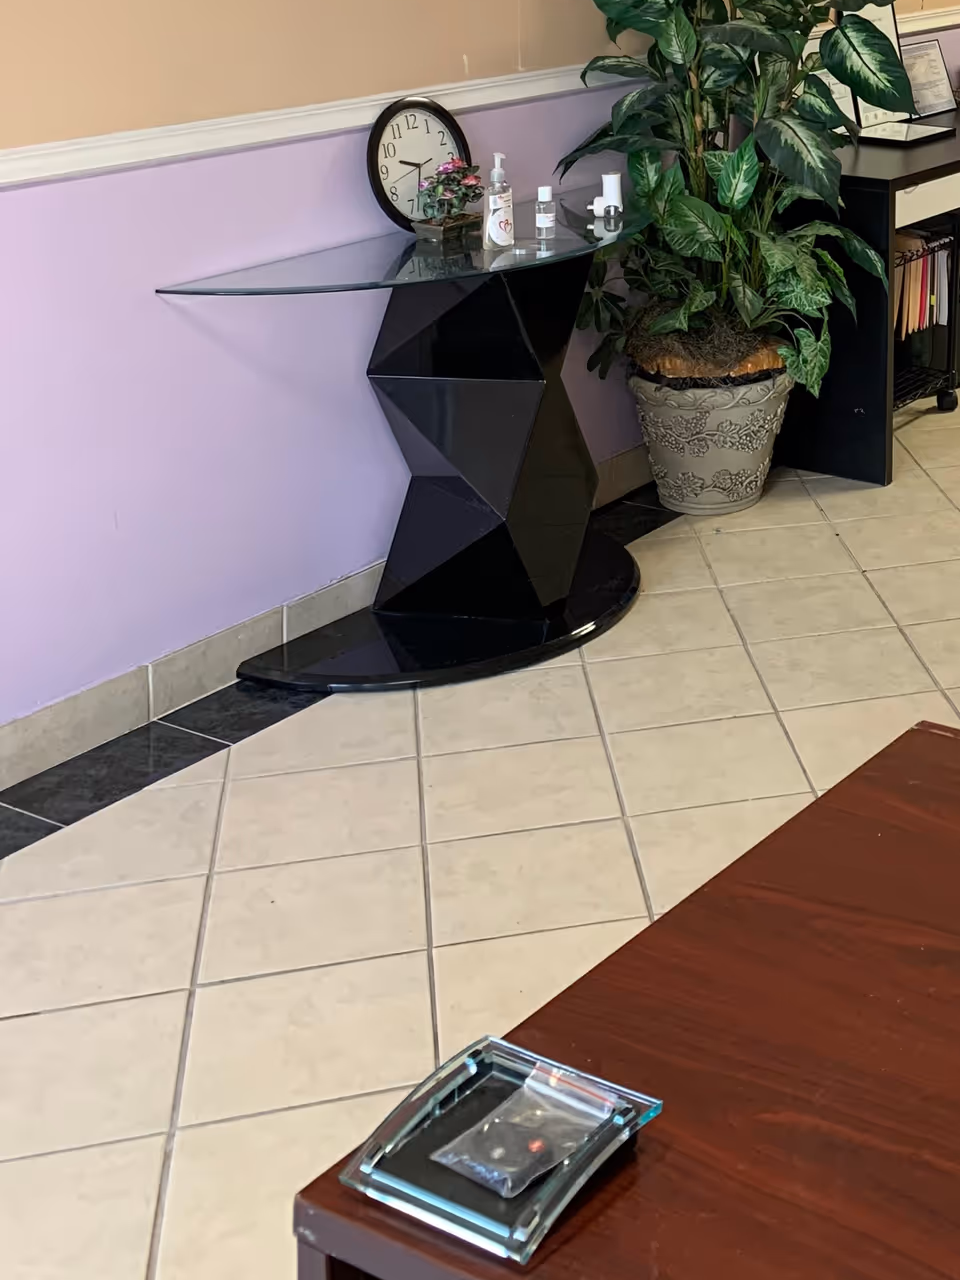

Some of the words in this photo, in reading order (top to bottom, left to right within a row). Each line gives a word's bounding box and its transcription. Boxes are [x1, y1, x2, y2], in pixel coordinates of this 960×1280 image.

[404, 113, 419, 130] 12
[424, 118, 431, 134] 1
[390, 123, 403, 140] 11
[438, 130, 447, 146] 2
[382, 142, 396, 159] 10
[380, 164, 389, 181] 9
[389, 186, 399, 202] 8
[407, 198, 415, 215] 7
